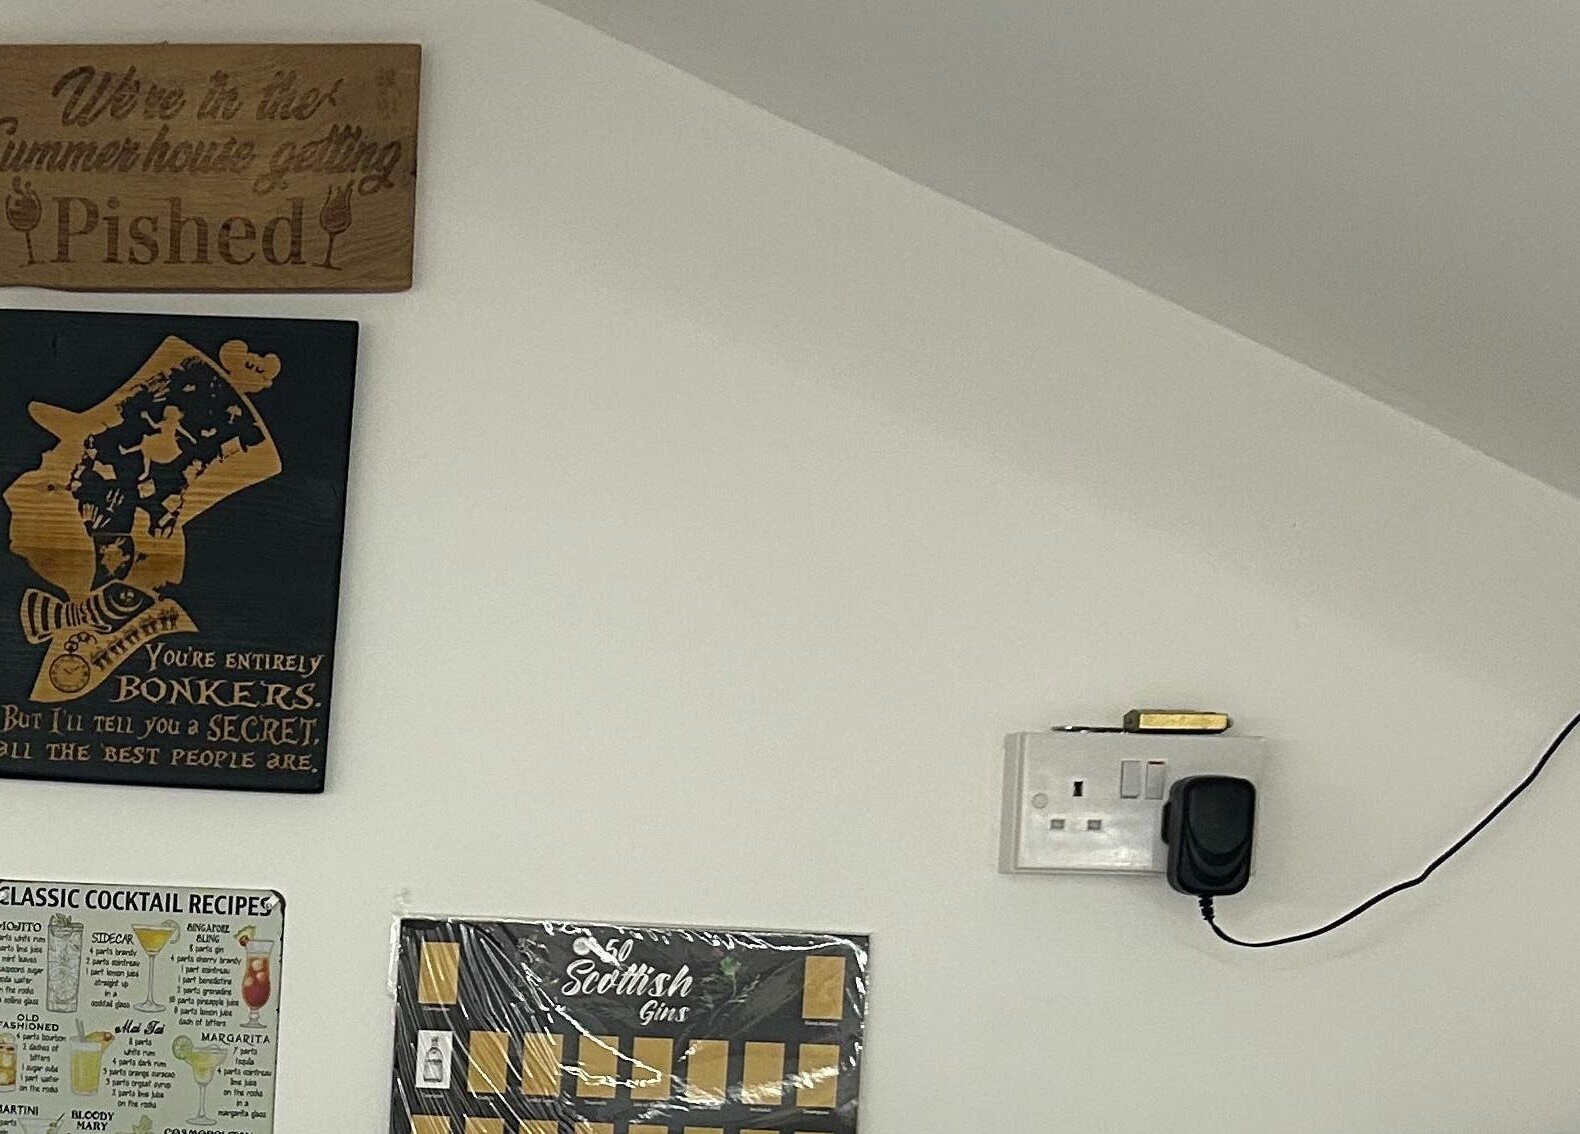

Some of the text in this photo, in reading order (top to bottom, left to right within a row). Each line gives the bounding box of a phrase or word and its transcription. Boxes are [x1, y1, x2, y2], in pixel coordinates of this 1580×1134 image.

[53, 65, 322, 127] We're in the
[253, 124, 404, 194] getting
[51, 197, 308, 265] Pished
[0, 886, 271, 917] CLASSIC COCKTAIL RECIPES
[92, 932, 134, 945] SIDECAR
[561, 959, 693, 998] Scottish
[17, 1014, 39, 1022] OLD
[639, 1000, 690, 1025] Gins
[144, 1020, 165, 1034] Tai
[201, 1033, 270, 1046] MARGARITA
[72, 1110, 115, 1121] BLOODY
[77, 1121, 108, 1131] MARY
